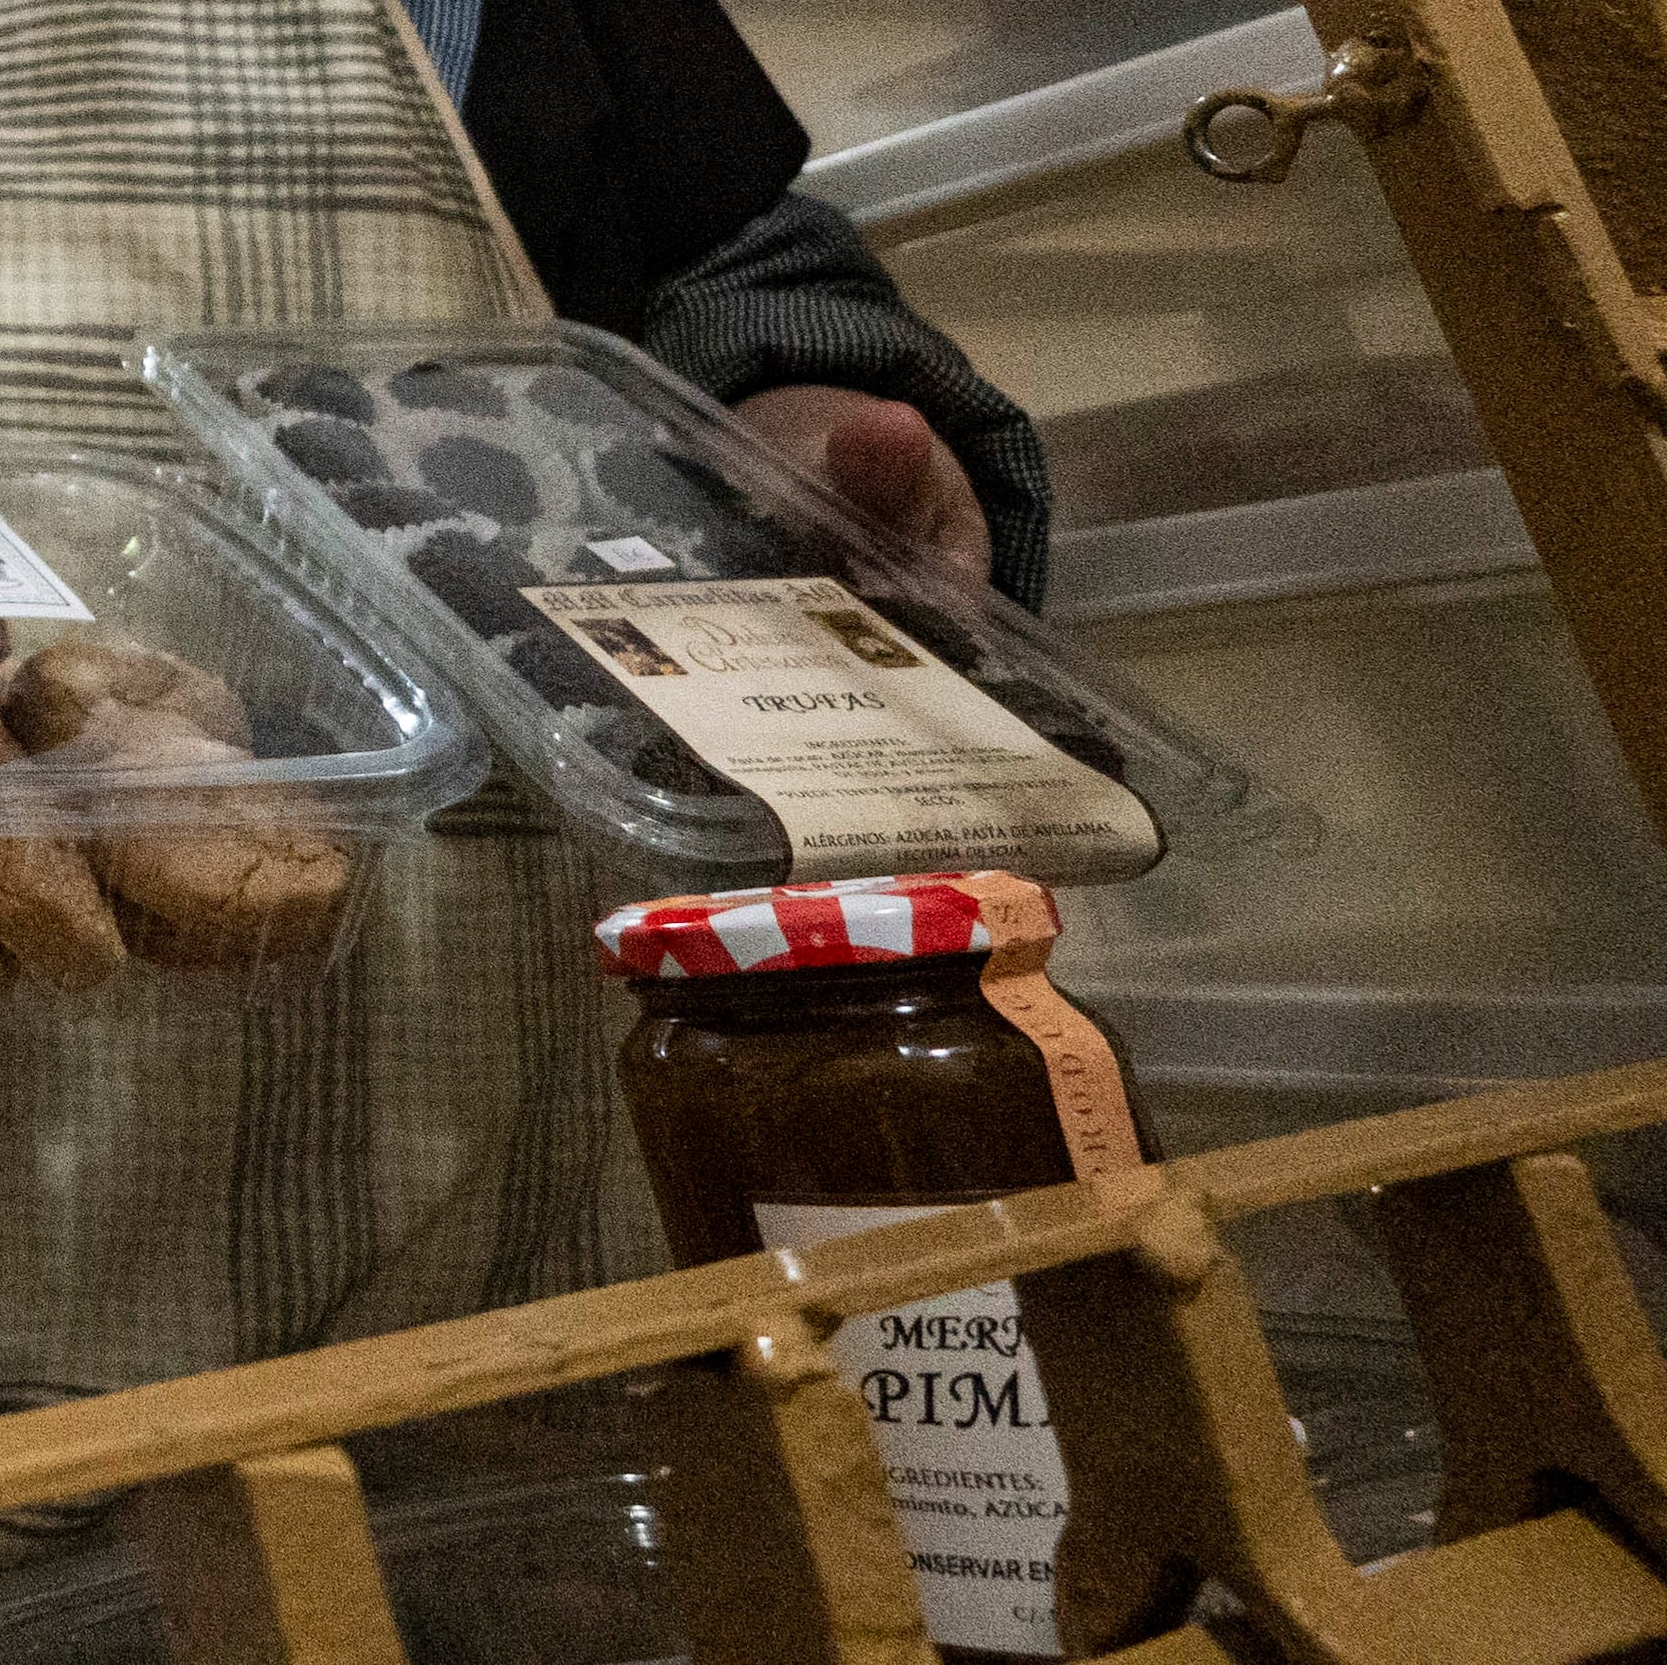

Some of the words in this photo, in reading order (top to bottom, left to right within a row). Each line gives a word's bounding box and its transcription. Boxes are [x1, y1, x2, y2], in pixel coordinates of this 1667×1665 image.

[742, 690, 885, 713] TRUFAS
[861, 1368, 1051, 1429] PIM
[888, 1466, 1045, 1492] GREDIENTES:
[985, 1496, 1068, 1519] AZÚCA
